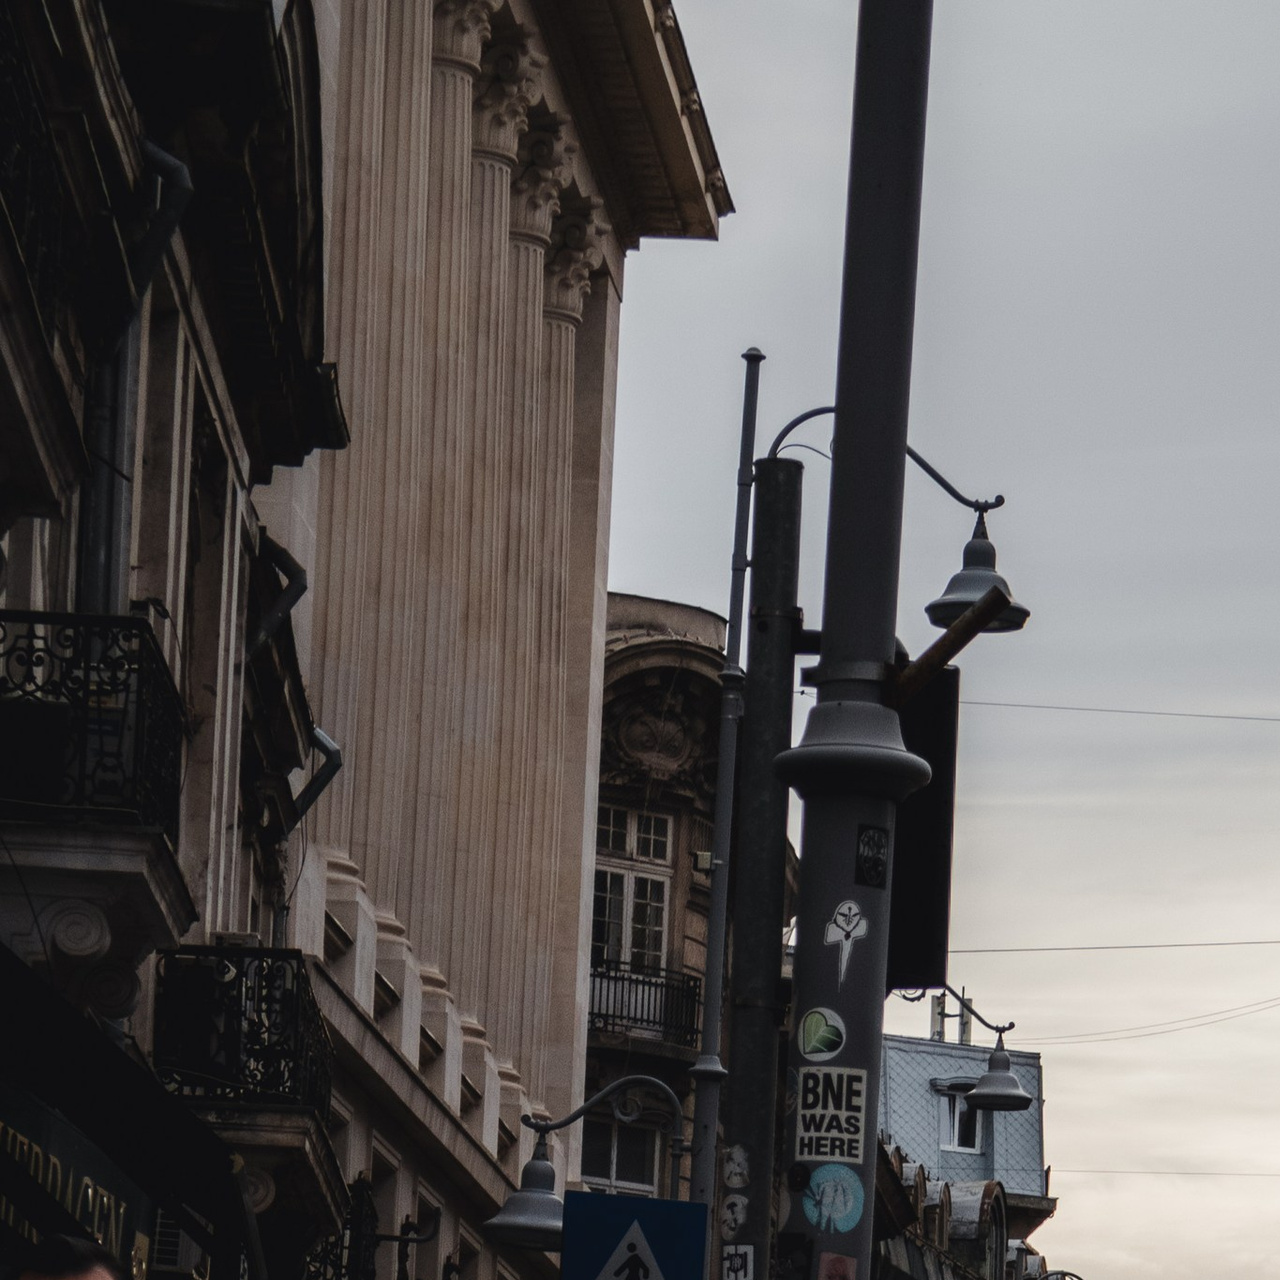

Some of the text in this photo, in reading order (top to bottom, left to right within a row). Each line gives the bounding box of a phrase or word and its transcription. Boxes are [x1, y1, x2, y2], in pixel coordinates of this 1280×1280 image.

[801, 1072, 862, 1113] BNE
[801, 1113, 860, 1135] WAS
[799, 1136, 860, 1158] HERE
